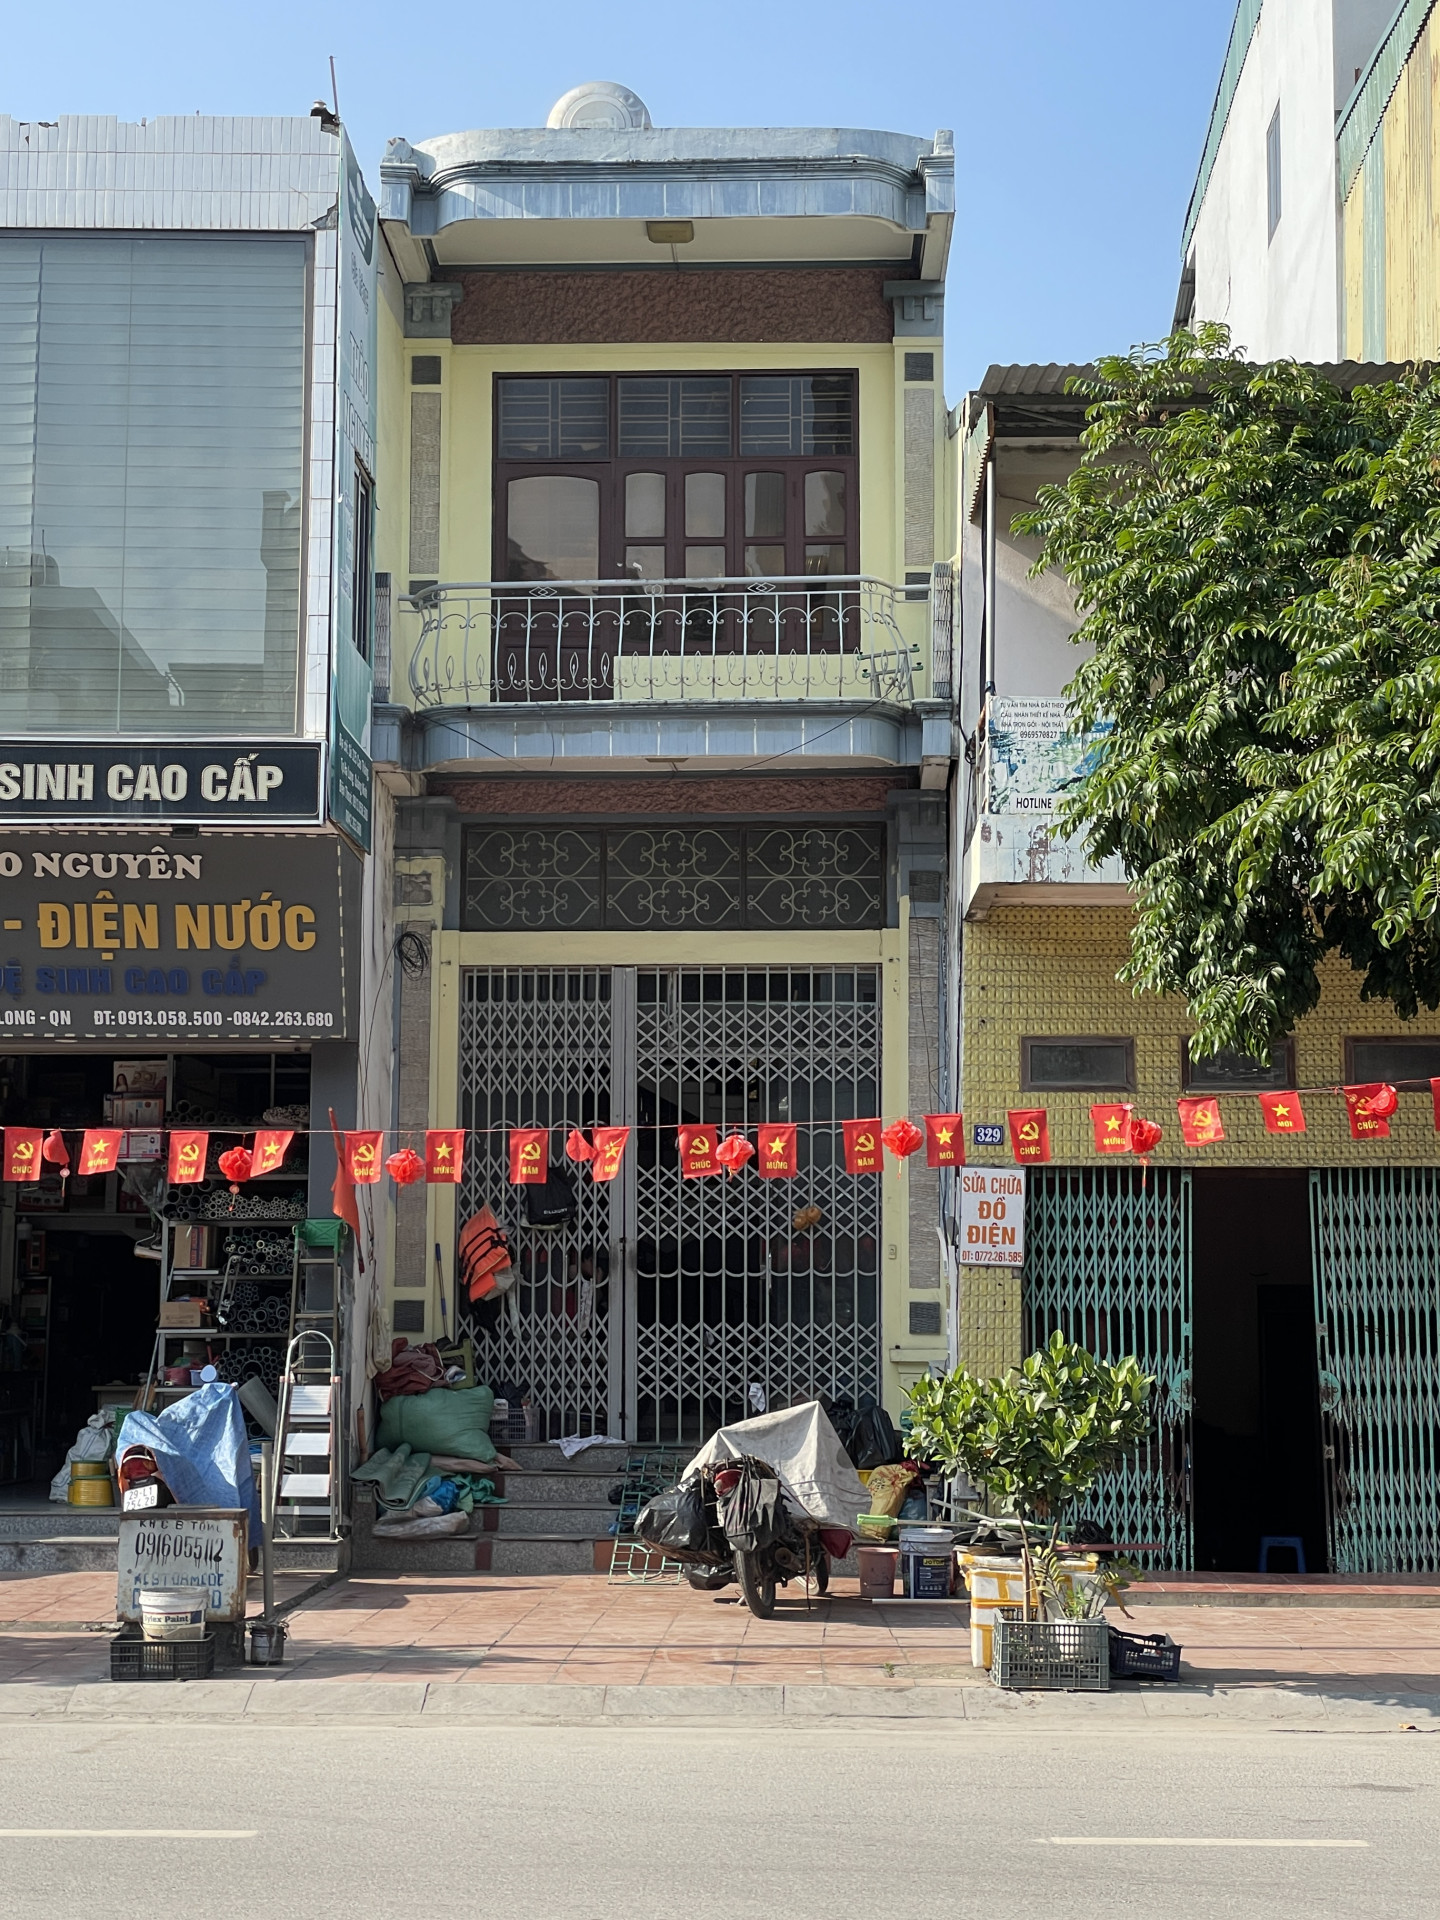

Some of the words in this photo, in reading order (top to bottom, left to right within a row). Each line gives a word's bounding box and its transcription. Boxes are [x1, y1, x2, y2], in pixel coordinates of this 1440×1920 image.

[0, 762, 94, 801] SINH
[107, 763, 188, 802] CAO
[201, 752, 284, 802] CẤP
[1016, 797, 1052, 810] HOTLINE
[32, 845, 203, 880] NGUYÊN
[37, 890, 160, 960] ĐIỆN
[174, 891, 316, 951] NƯỚC
[36, 965, 112, 995] SINH
[124, 966, 190, 996] CAO
[201, 953, 266, 997] CẤP
[50, 1010, 71, 1027] QN
[1357, 1120, 1378, 1130] CHÚC
[977, 1127, 1001, 1142] 329
[1020, 1146, 1040, 1155] CHÚC
[690, 1160, 711, 1170] CHÚC
[766, 1160, 788, 1170] MỪNG
[857, 1156, 875, 1166] NĂM
[12, 1164, 32, 1174] CHÚC
[354, 1167, 374, 1176] CHÚC
[522, 1166, 538, 1175] NĂM
[963, 1171, 986, 1194] SỬA
[991, 1174, 1022, 1195] CHỮA
[978, 1196, 1006, 1220] ĐỒ
[967, 1222, 1016, 1248] ĐIỆN
